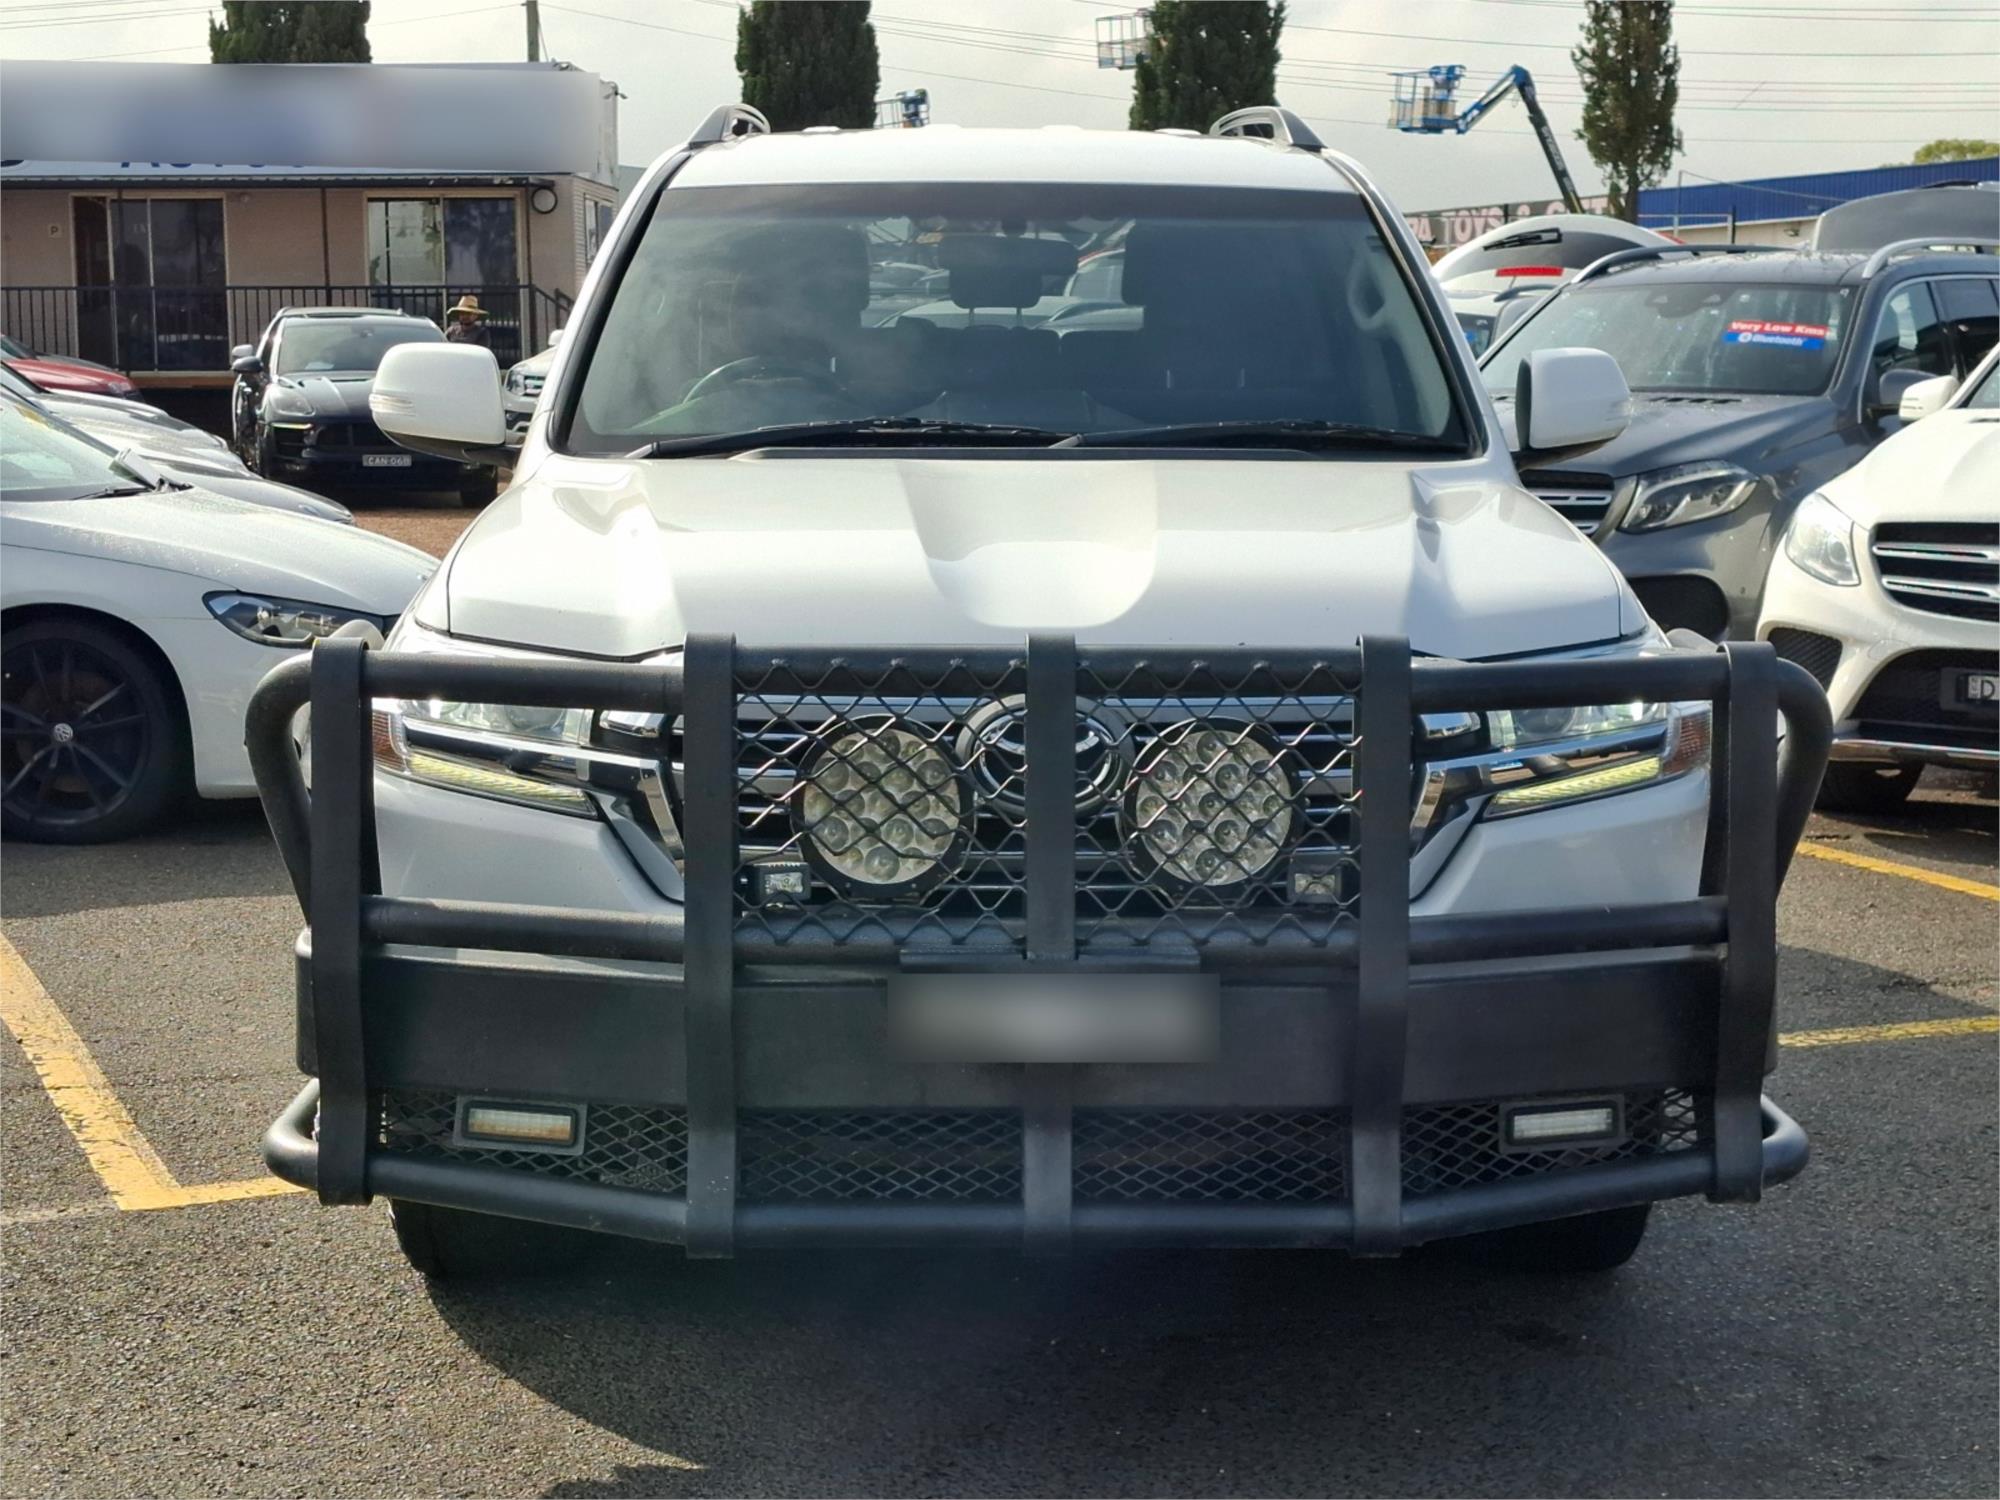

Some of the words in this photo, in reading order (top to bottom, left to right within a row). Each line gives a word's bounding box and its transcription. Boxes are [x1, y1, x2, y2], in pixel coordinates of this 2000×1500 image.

[1441, 207, 1504, 243] TOYS
[1732, 321, 1762, 332] Very
[1764, 323, 1793, 333] Low
[1795, 325, 1825, 336] Kms
